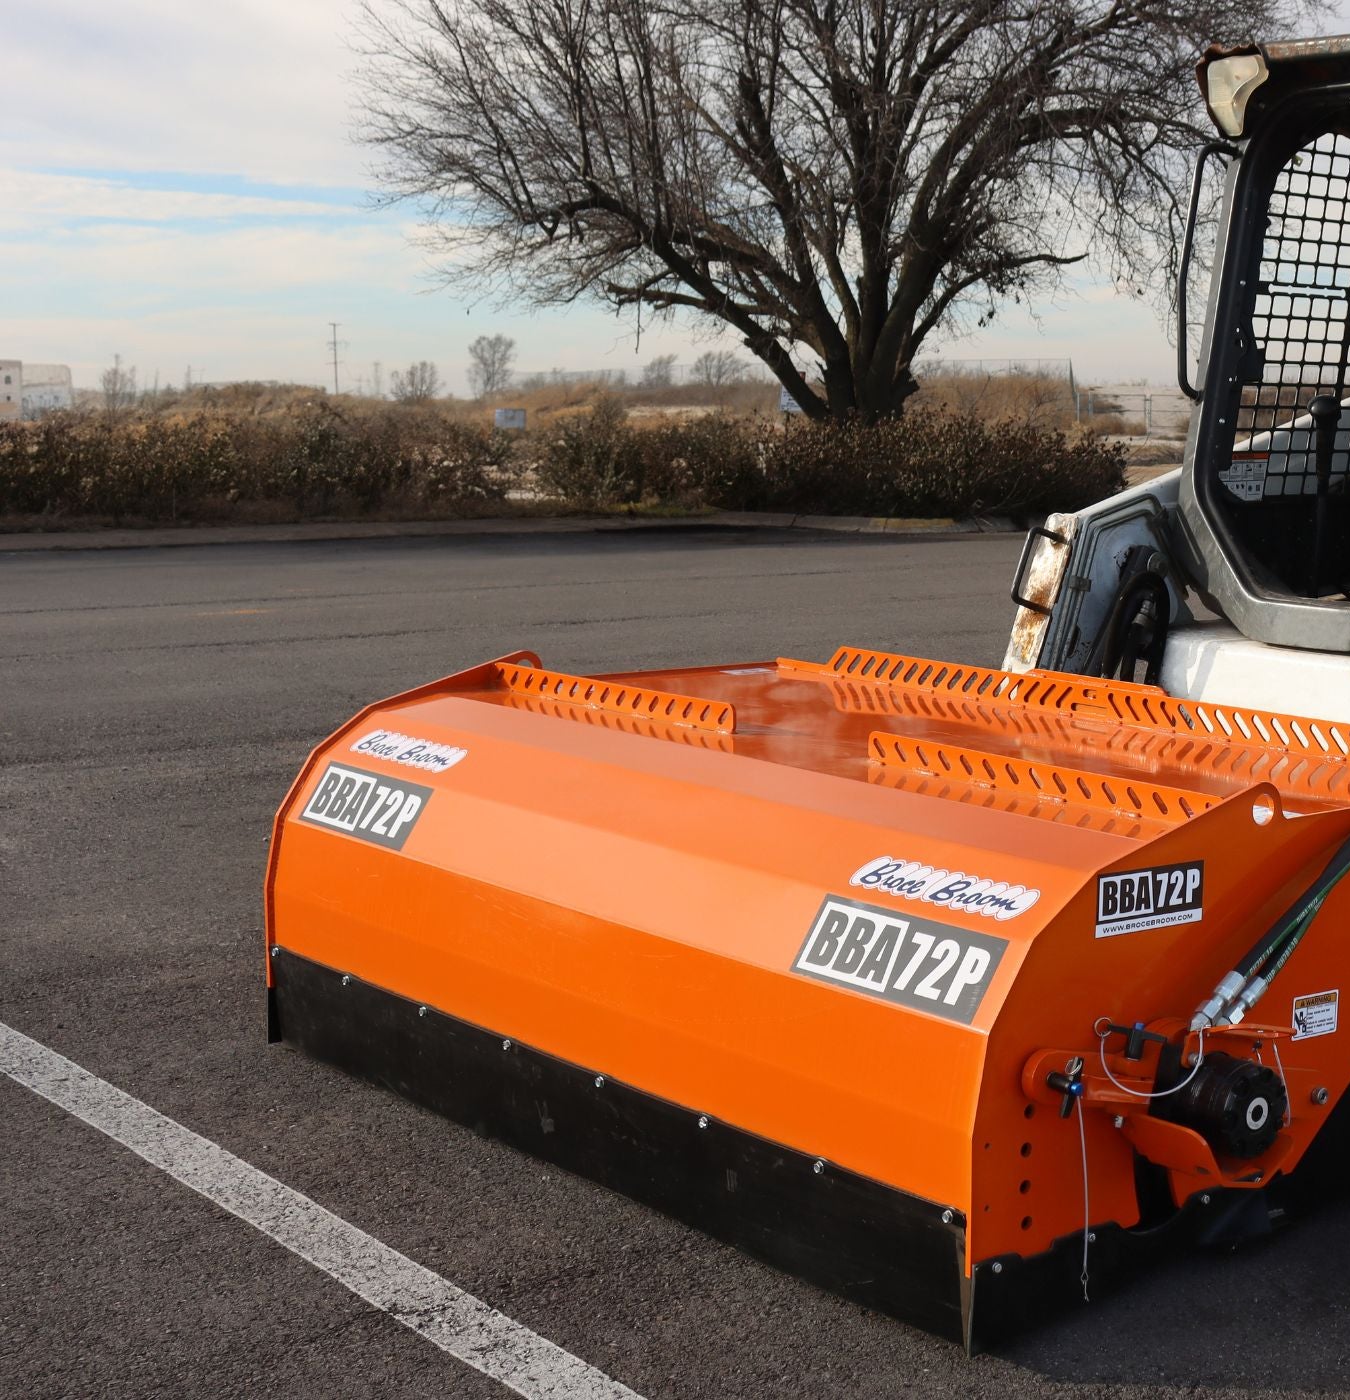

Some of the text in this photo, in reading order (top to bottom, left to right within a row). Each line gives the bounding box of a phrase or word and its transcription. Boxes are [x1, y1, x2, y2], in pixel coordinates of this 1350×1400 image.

[358, 734, 449, 766] Broce Broom
[859, 862, 1019, 911] Broce Broom
[1102, 913, 1193, 934] WWW.BROCEBROOM.COM
